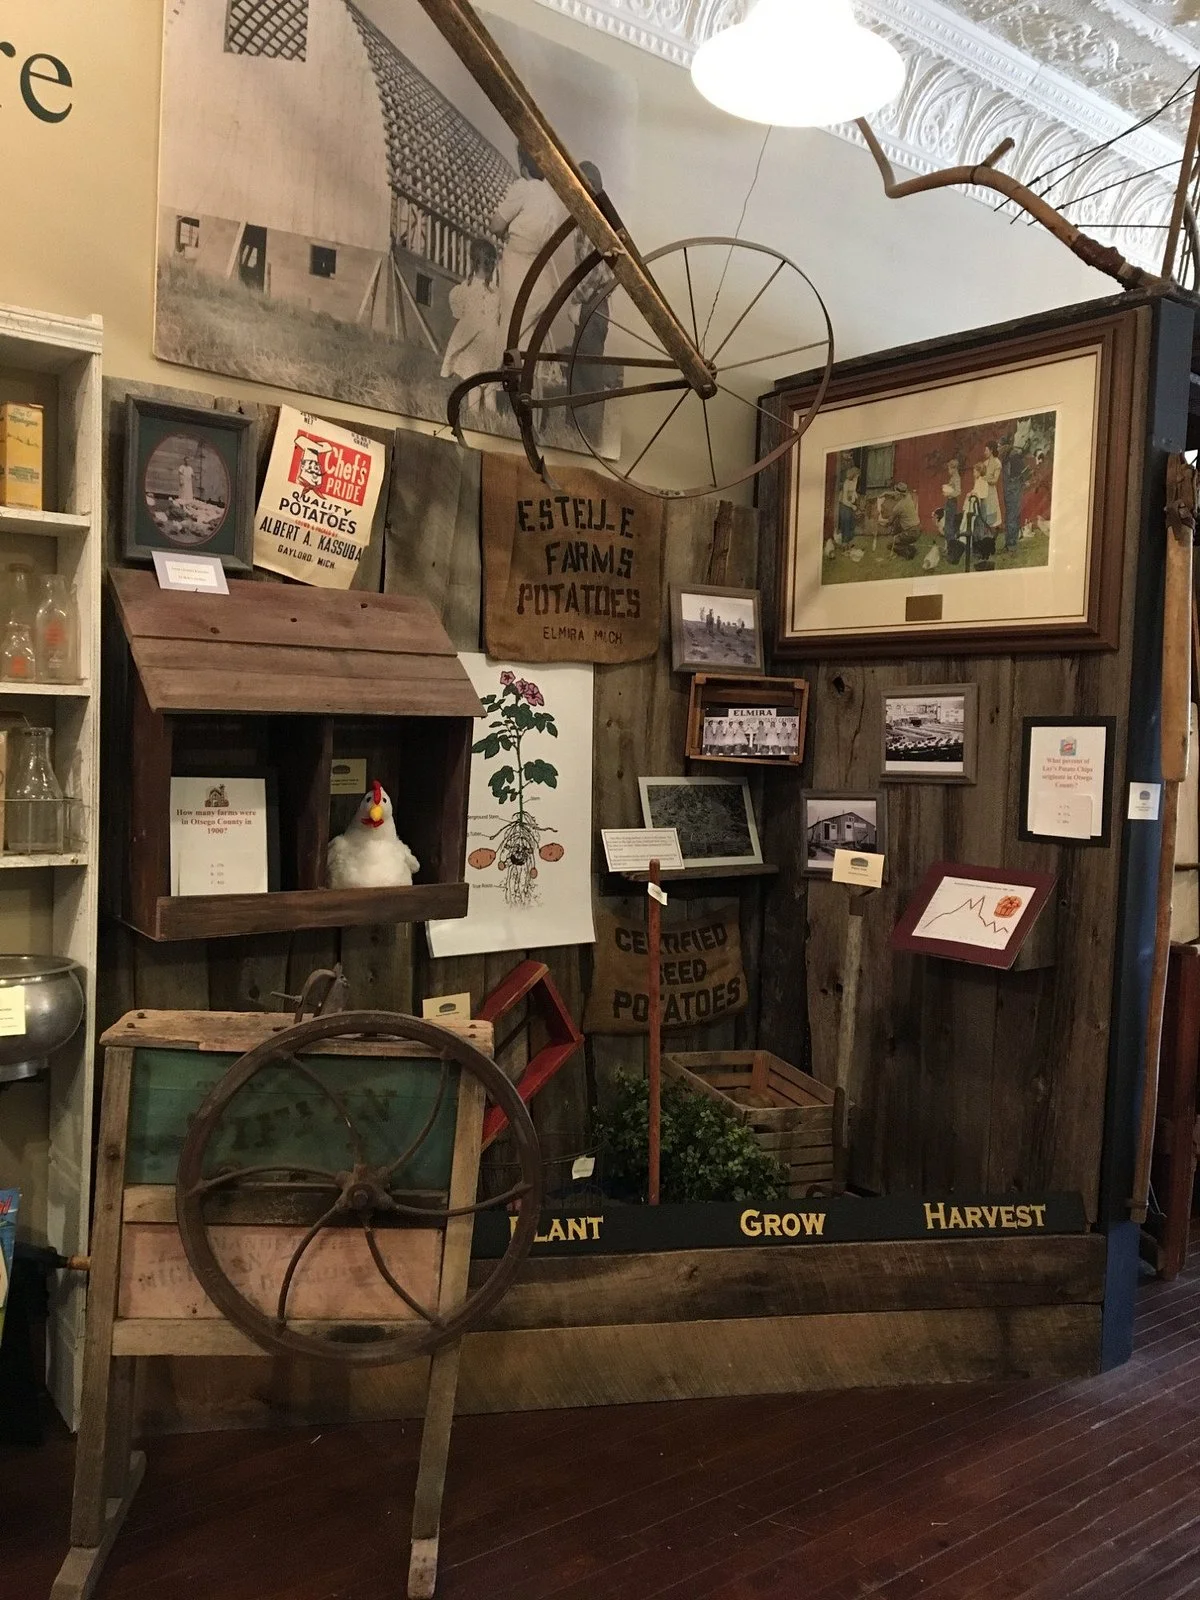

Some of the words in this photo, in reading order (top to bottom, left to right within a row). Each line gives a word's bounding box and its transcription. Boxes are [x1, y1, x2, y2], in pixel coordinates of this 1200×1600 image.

[0, 41, 72, 124] e
[324, 447, 368, 486] Chef's
[292, 491, 353, 517] QUALITY
[325, 477, 364, 503] PRIDE
[279, 498, 357, 535] POTATOES
[517, 496, 635, 539] ESTELLE
[259, 516, 301, 542] ALBERT
[302, 530, 312, 547] A.
[317, 535, 363, 562] KASSUBA
[545, 541, 634, 579] FARMS
[516, 582, 641, 619] POTATOES
[543, 626, 585, 641] ELMIRA
[190, 818, 216, 826] Otsego
[217, 818, 244, 827] County
[195, 810, 215, 818] many
[615, 923, 728, 955] CETIFIED
[659, 958, 707, 986] EED
[613, 976, 741, 1023] POATOES
